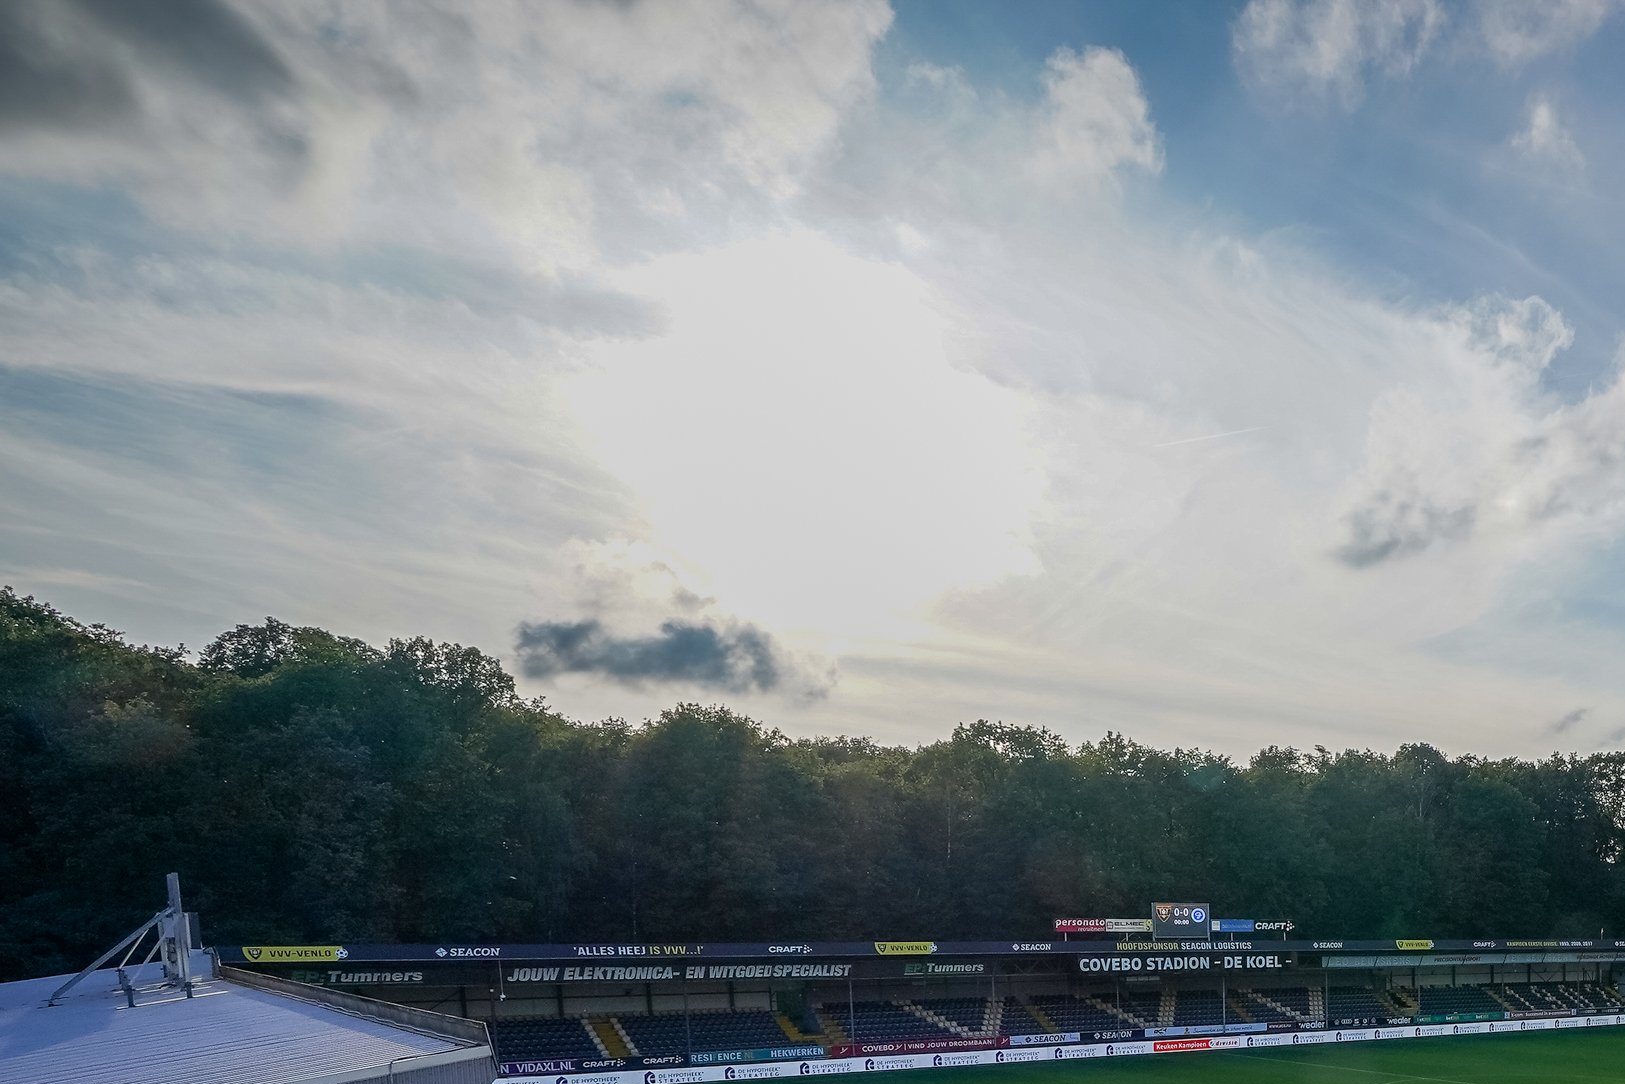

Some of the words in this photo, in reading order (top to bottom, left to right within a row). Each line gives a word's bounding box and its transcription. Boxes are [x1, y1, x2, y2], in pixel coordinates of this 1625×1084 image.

[1174, 907, 1189, 917] 0-0
[1055, 918, 1106, 929] personato
[1255, 922, 1286, 930] CRAFT
[618, 946, 646, 955] HEEJ
[649, 946, 662, 955] IS
[768, 945, 803, 954] CRAFT
[1020, 943, 1052, 952] SEACON
[1116, 942, 1179, 951] HOOFDSPONSOR
[1181, 941, 1212, 950] SEACON
[1213, 941, 1252, 950] LOGISTICS
[270, 950, 331, 958] VVV-VENLO
[450, 947, 500, 957] SEACON
[927, 961, 985, 974] Tummers
[1079, 957, 1142, 972] COVEBO
[1145, 956, 1210, 971] STADION
[1223, 956, 1242, 969] DE
[1246, 955, 1282, 969] KOEL
[327, 971, 423, 984] Tummers
[507, 967, 560, 982] JOUW
[563, 966, 681, 981] ELEKTRONICA-
[685, 966, 706, 980] EN
[1034, 1034, 1066, 1043] SEACON
[1101, 1030, 1132, 1039] SEACON
[861, 1043, 894, 1053] COVEBO
[1178, 1041, 1207, 1049] Kampioen
[770, 1046, 825, 1058] HEKWERKEN
[582, 1060, 616, 1068] CRAFT
[643, 1056, 675, 1065] CRAFT
[516, 1062, 576, 1073] VIDAXL.NL
[658, 1076, 703, 1084] STRATEEG
